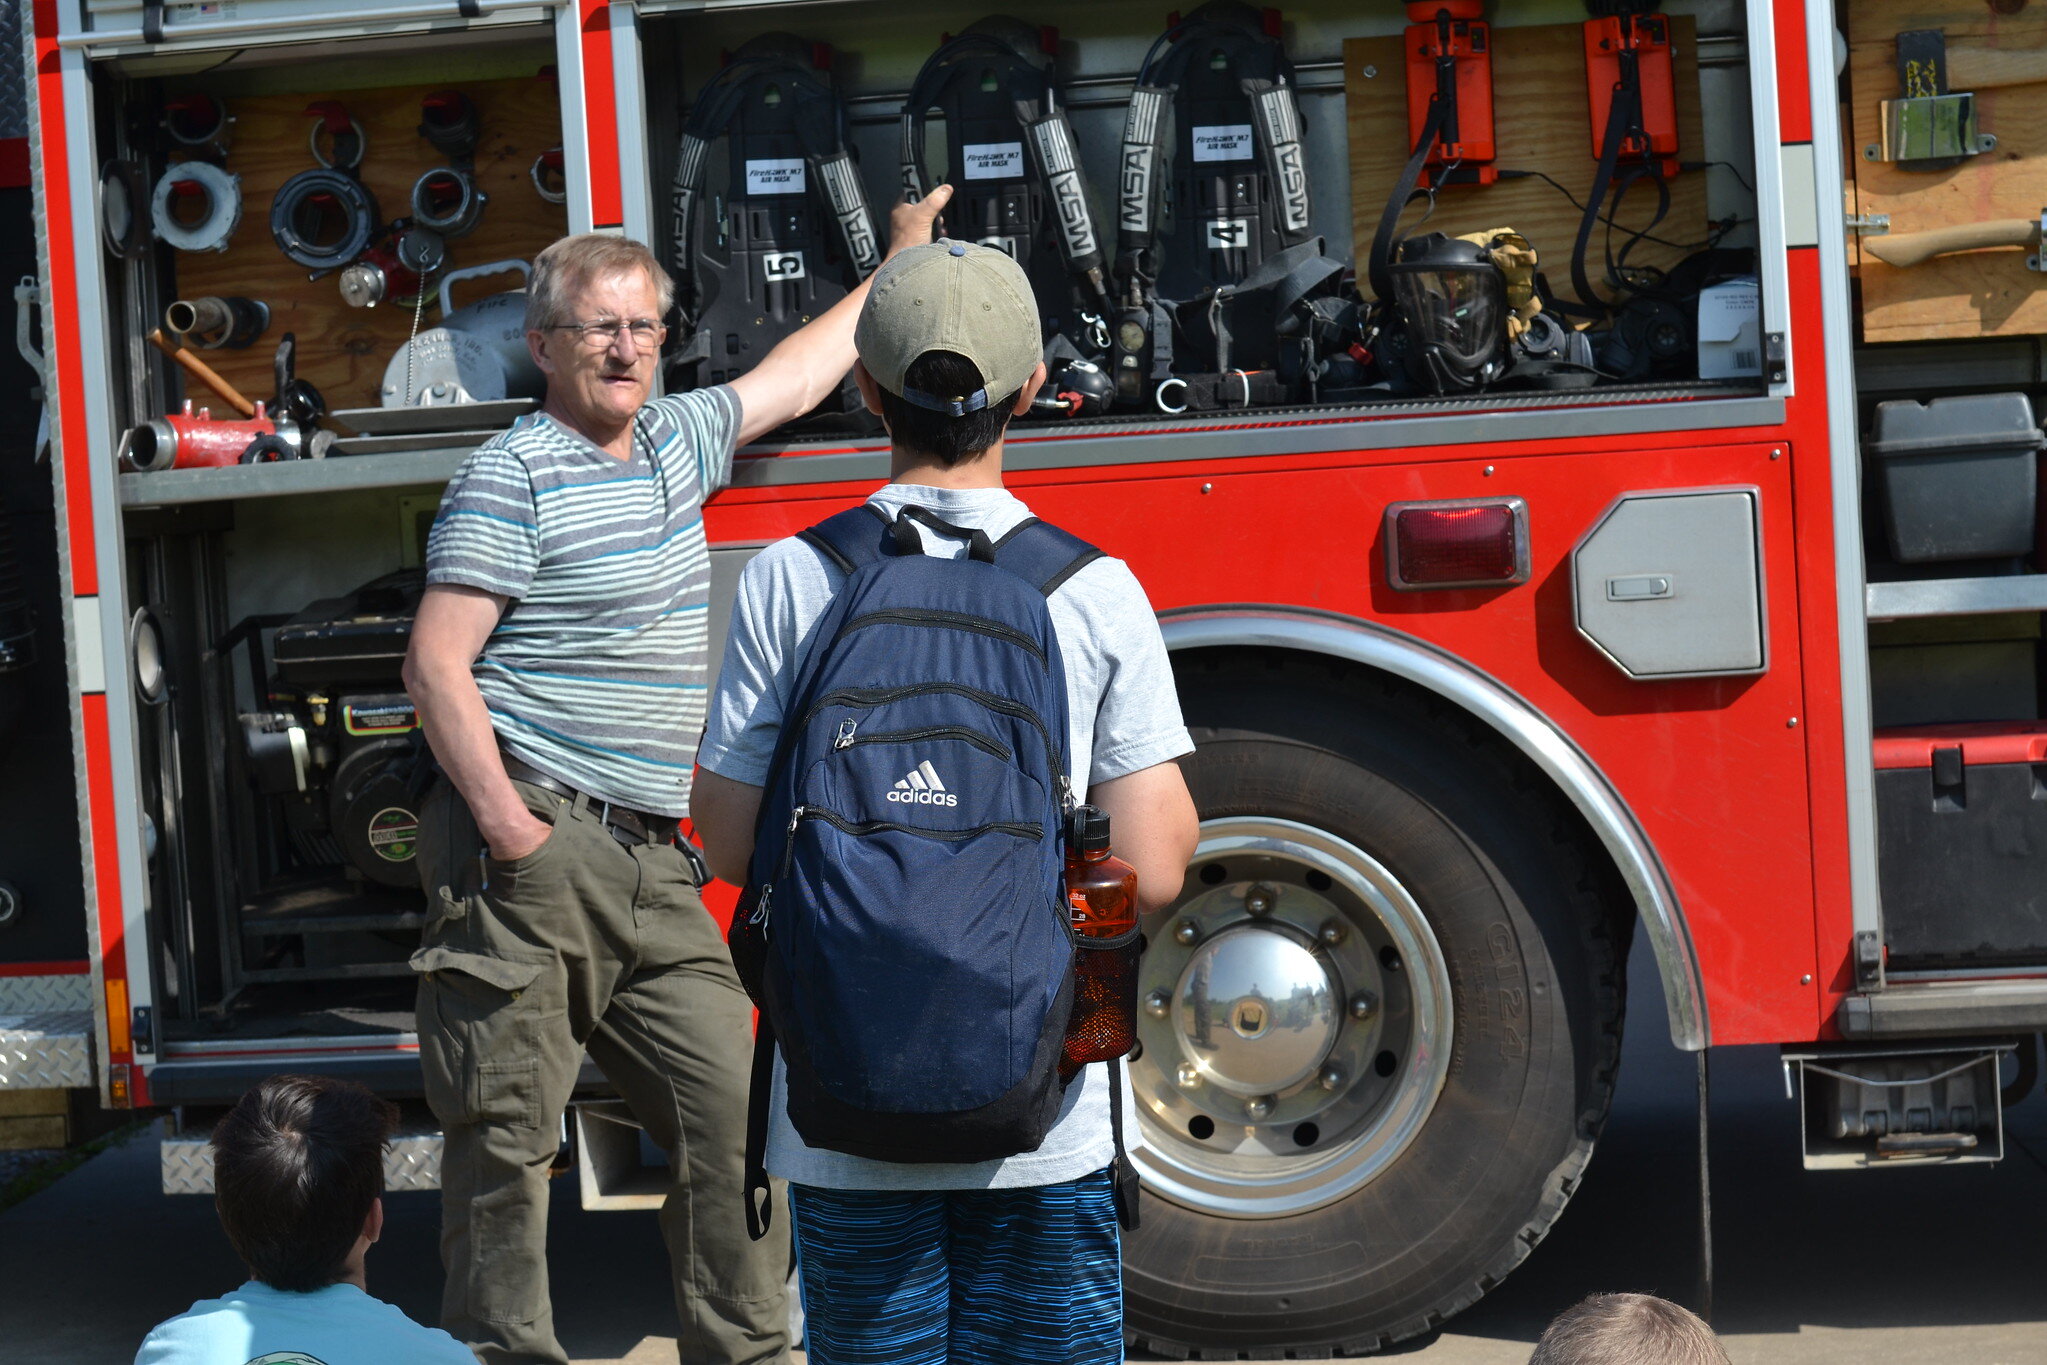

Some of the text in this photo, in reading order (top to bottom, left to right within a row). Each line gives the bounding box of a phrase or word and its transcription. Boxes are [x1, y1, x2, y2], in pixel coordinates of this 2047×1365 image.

[1236, 134, 1249, 142] M7
[790, 168, 802, 176] M7
[978, 160, 990, 168] AIR
[760, 175, 791, 184] AIR MASK
[1122, 148, 1148, 226] MSA
[1280, 146, 1306, 222] MSA
[1055, 175, 1092, 251] MSA
[1210, 223, 1244, 244] 4
[768, 256, 800, 276] 5
[886, 788, 958, 807] adidas
